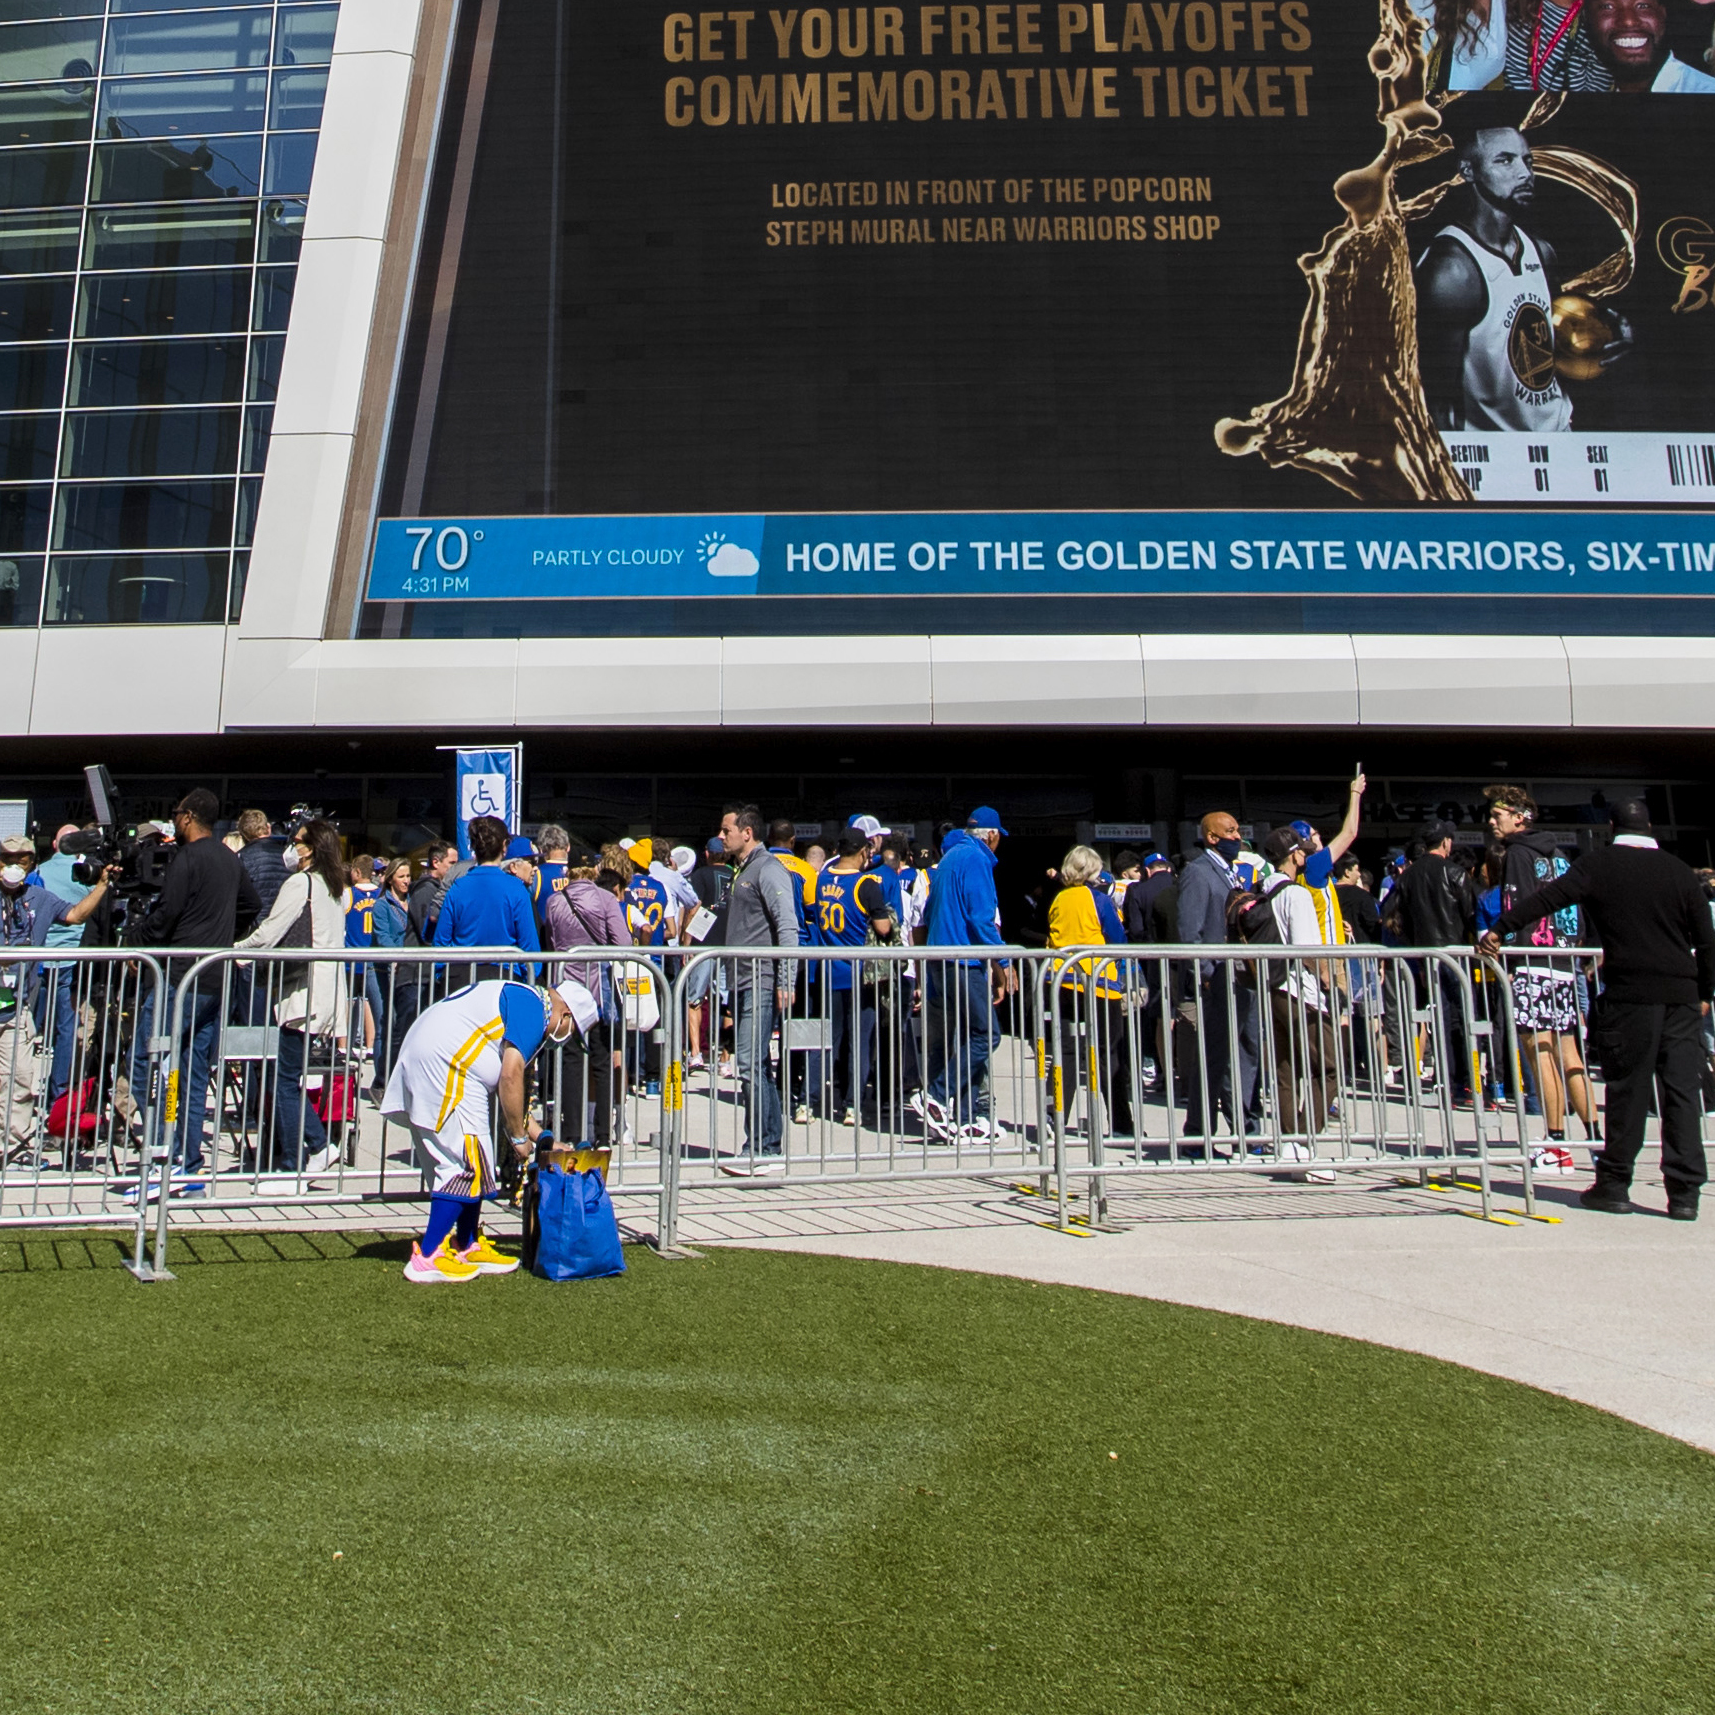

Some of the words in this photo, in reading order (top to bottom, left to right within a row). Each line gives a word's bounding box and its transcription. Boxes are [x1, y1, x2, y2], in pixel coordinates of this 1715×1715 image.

[663, 11, 755, 63] GET
[768, 7, 905, 59] YOUR
[920, 4, 1043, 56] FREE
[1058, 1, 1312, 53] PLAYOFFS
[664, 68, 1120, 127] COMMEMORATIVE
[1132, 66, 1313, 118] TICKET
[772, 181, 878, 208] LOCATED
[886, 181, 910, 205] IN
[917, 180, 997, 205] FRONT
[1003, 178, 1034, 203] OF
[1041, 178, 1087, 203] THE
[1093, 177, 1212, 202] POPCORN
[765, 219, 844, 246] STEPH
[851, 218, 936, 244] MURAL
[942, 217, 1005, 242] NEAR
[1012, 215, 1148, 242] WARRIORS
[1153, 215, 1221, 241] SHOP
[1504, 293, 1525, 328] GOLDEN
[1528, 292, 1550, 313] STATE
[1531, 321, 1548, 345] 30
[1450, 445, 1490, 463] SECTION
[1528, 445, 1550, 463] ROW
[1587, 445, 1609, 463] SEAT
[1462, 468, 1482, 491] VIP
[1534, 468, 1550, 492] 01
[1594, 468, 1609, 492] 01
[532, 549, 603, 566] PARTLY
[607, 548, 685, 565] CLOUDY
[786, 542, 897, 572] HOME
[907, 541, 959, 572] OF
[969, 541, 1045, 571] THE
[1056, 540, 1217, 571] GOLDEN
[1229, 539, 1347, 571] STATE
[1355, 540, 1576, 576] WARRIORS,
[401, 577, 438, 594] 4:31
[442, 575, 470, 593] PM
[821, 884, 845, 900] CURRY
[818, 900, 845, 934] 30
